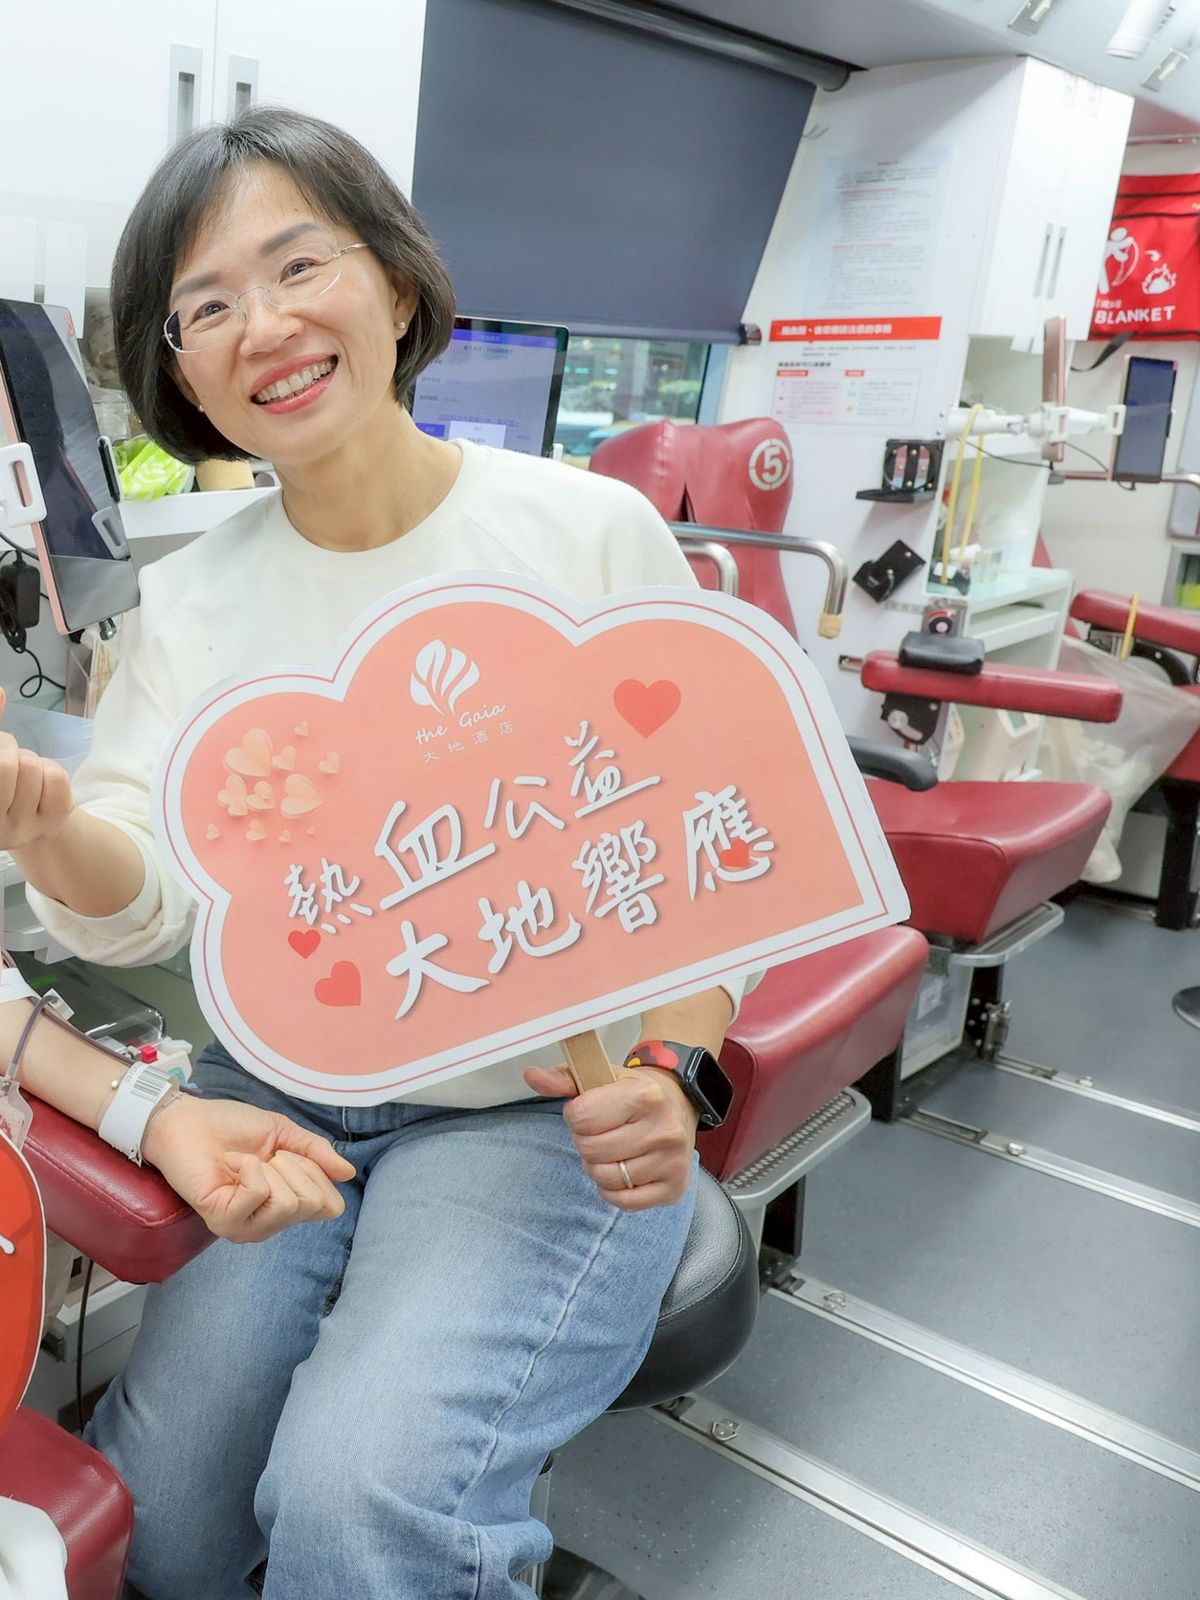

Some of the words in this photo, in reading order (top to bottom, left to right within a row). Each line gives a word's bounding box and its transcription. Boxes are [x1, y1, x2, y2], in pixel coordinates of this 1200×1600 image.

[1095, 305, 1176, 324] BLANKET
[416, 725, 448, 744] the
[459, 704, 506, 727] Gaia
[424, 720, 512, 763] 大地酒店
[285, 720, 661, 934] 熱血公益
[386, 784, 775, 1020] 大地響應
